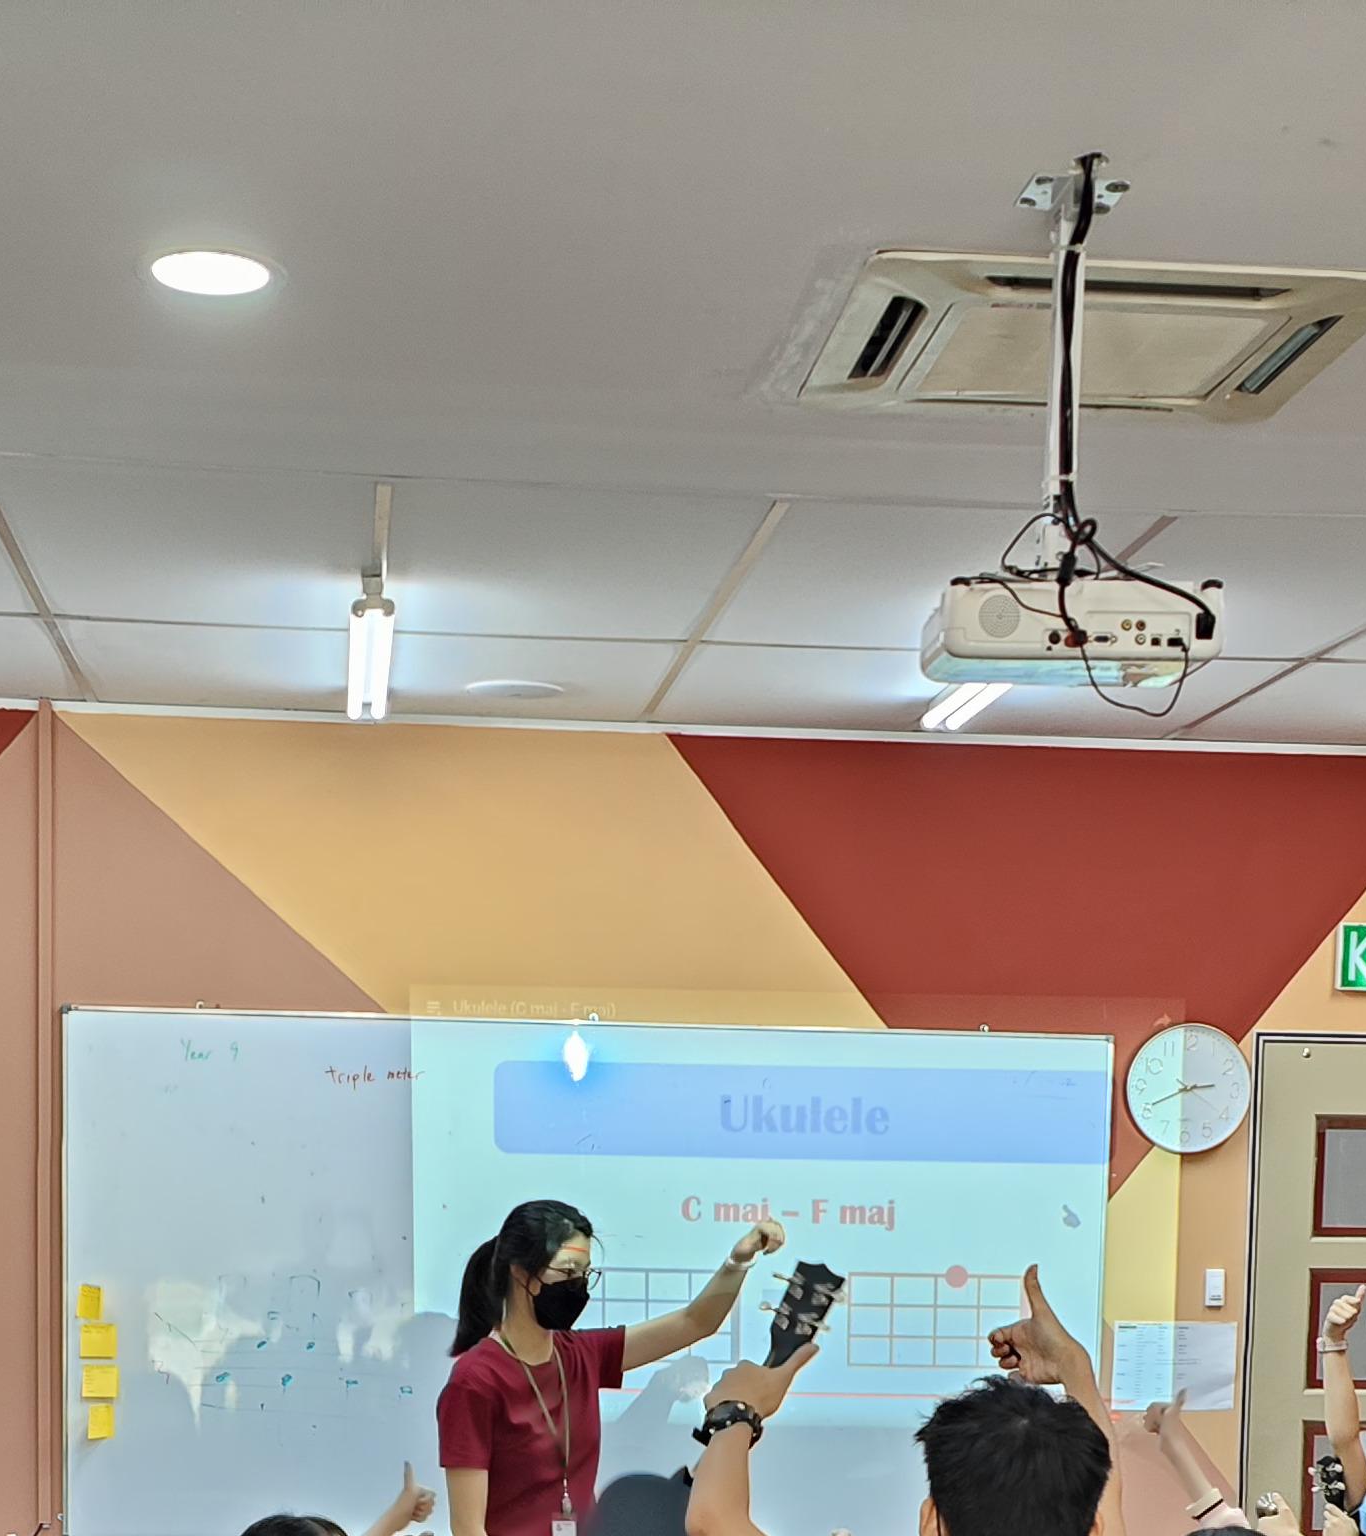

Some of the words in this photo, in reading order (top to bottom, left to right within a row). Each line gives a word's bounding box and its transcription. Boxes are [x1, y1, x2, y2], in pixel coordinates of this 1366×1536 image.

[453, 1000, 508, 1015] Ukulele
[181, 1039, 211, 1062] Year
[324, 1065, 375, 1091] triple
[720, 1094, 891, 1135] Ukulele
[681, 1195, 702, 1222] C
[811, 1199, 829, 1224] F
[839, 1199, 896, 1231] maj
